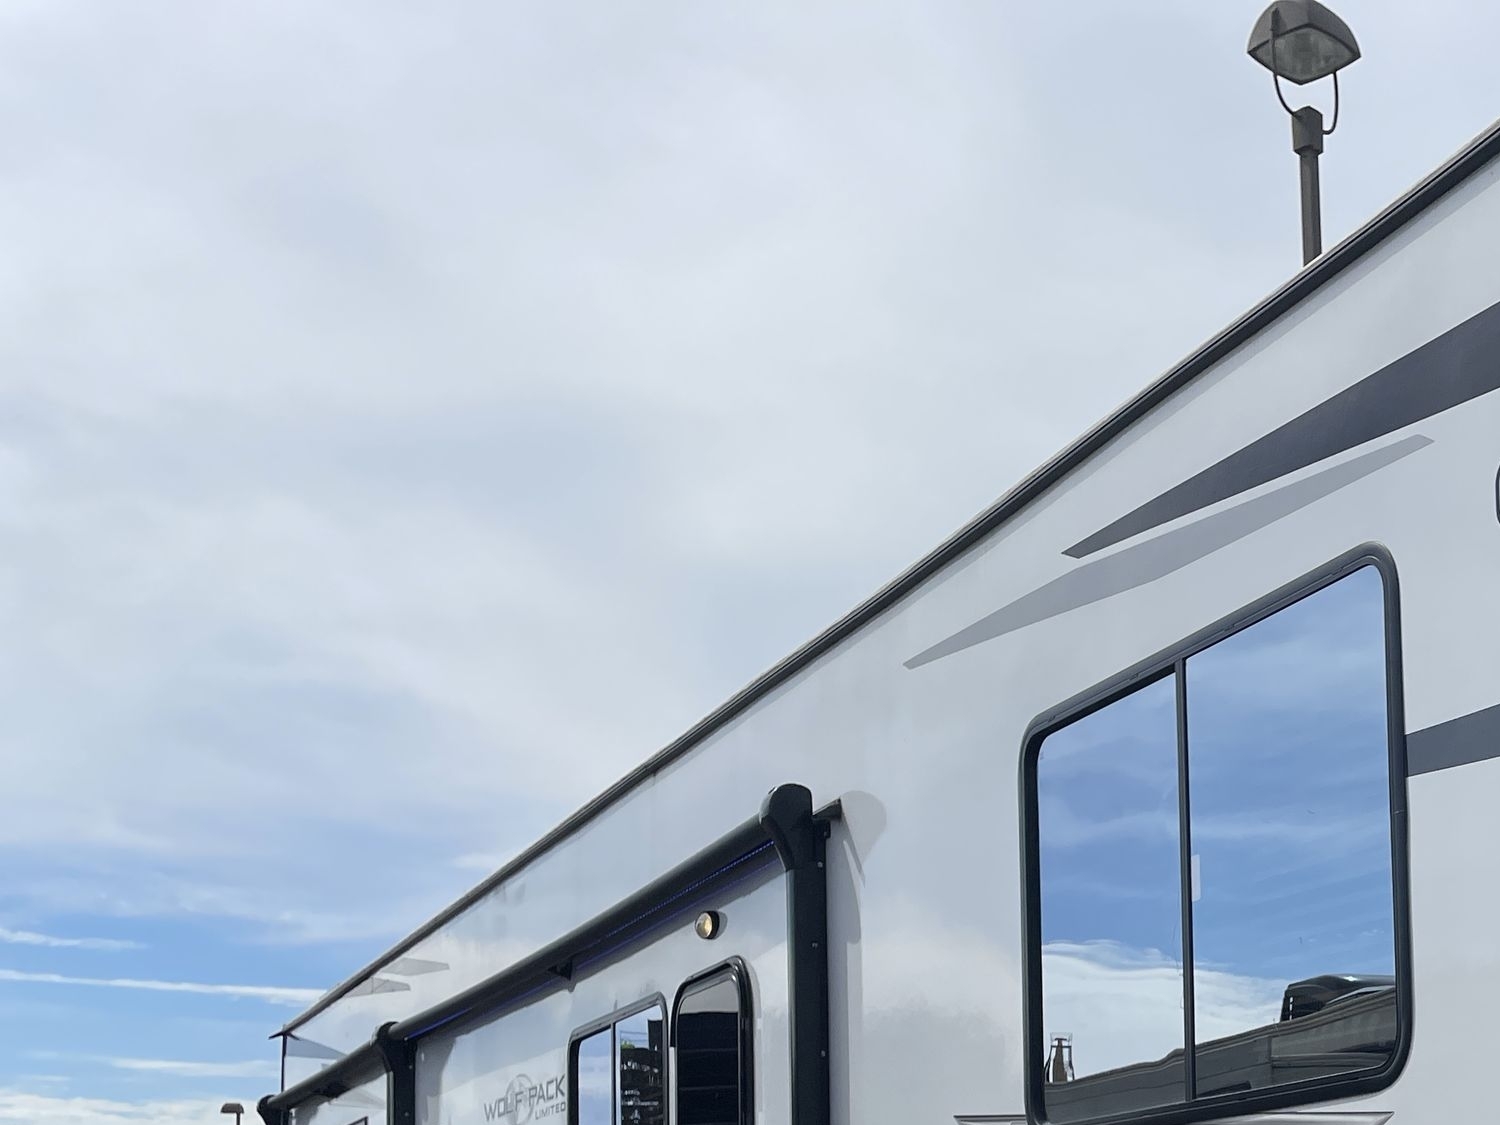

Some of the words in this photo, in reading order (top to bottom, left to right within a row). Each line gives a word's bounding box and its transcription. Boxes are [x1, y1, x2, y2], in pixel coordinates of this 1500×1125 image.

[483, 1090, 524, 1122] WOLF
[528, 1073, 566, 1107] PACK
[534, 1101, 566, 1120] LIMITED
